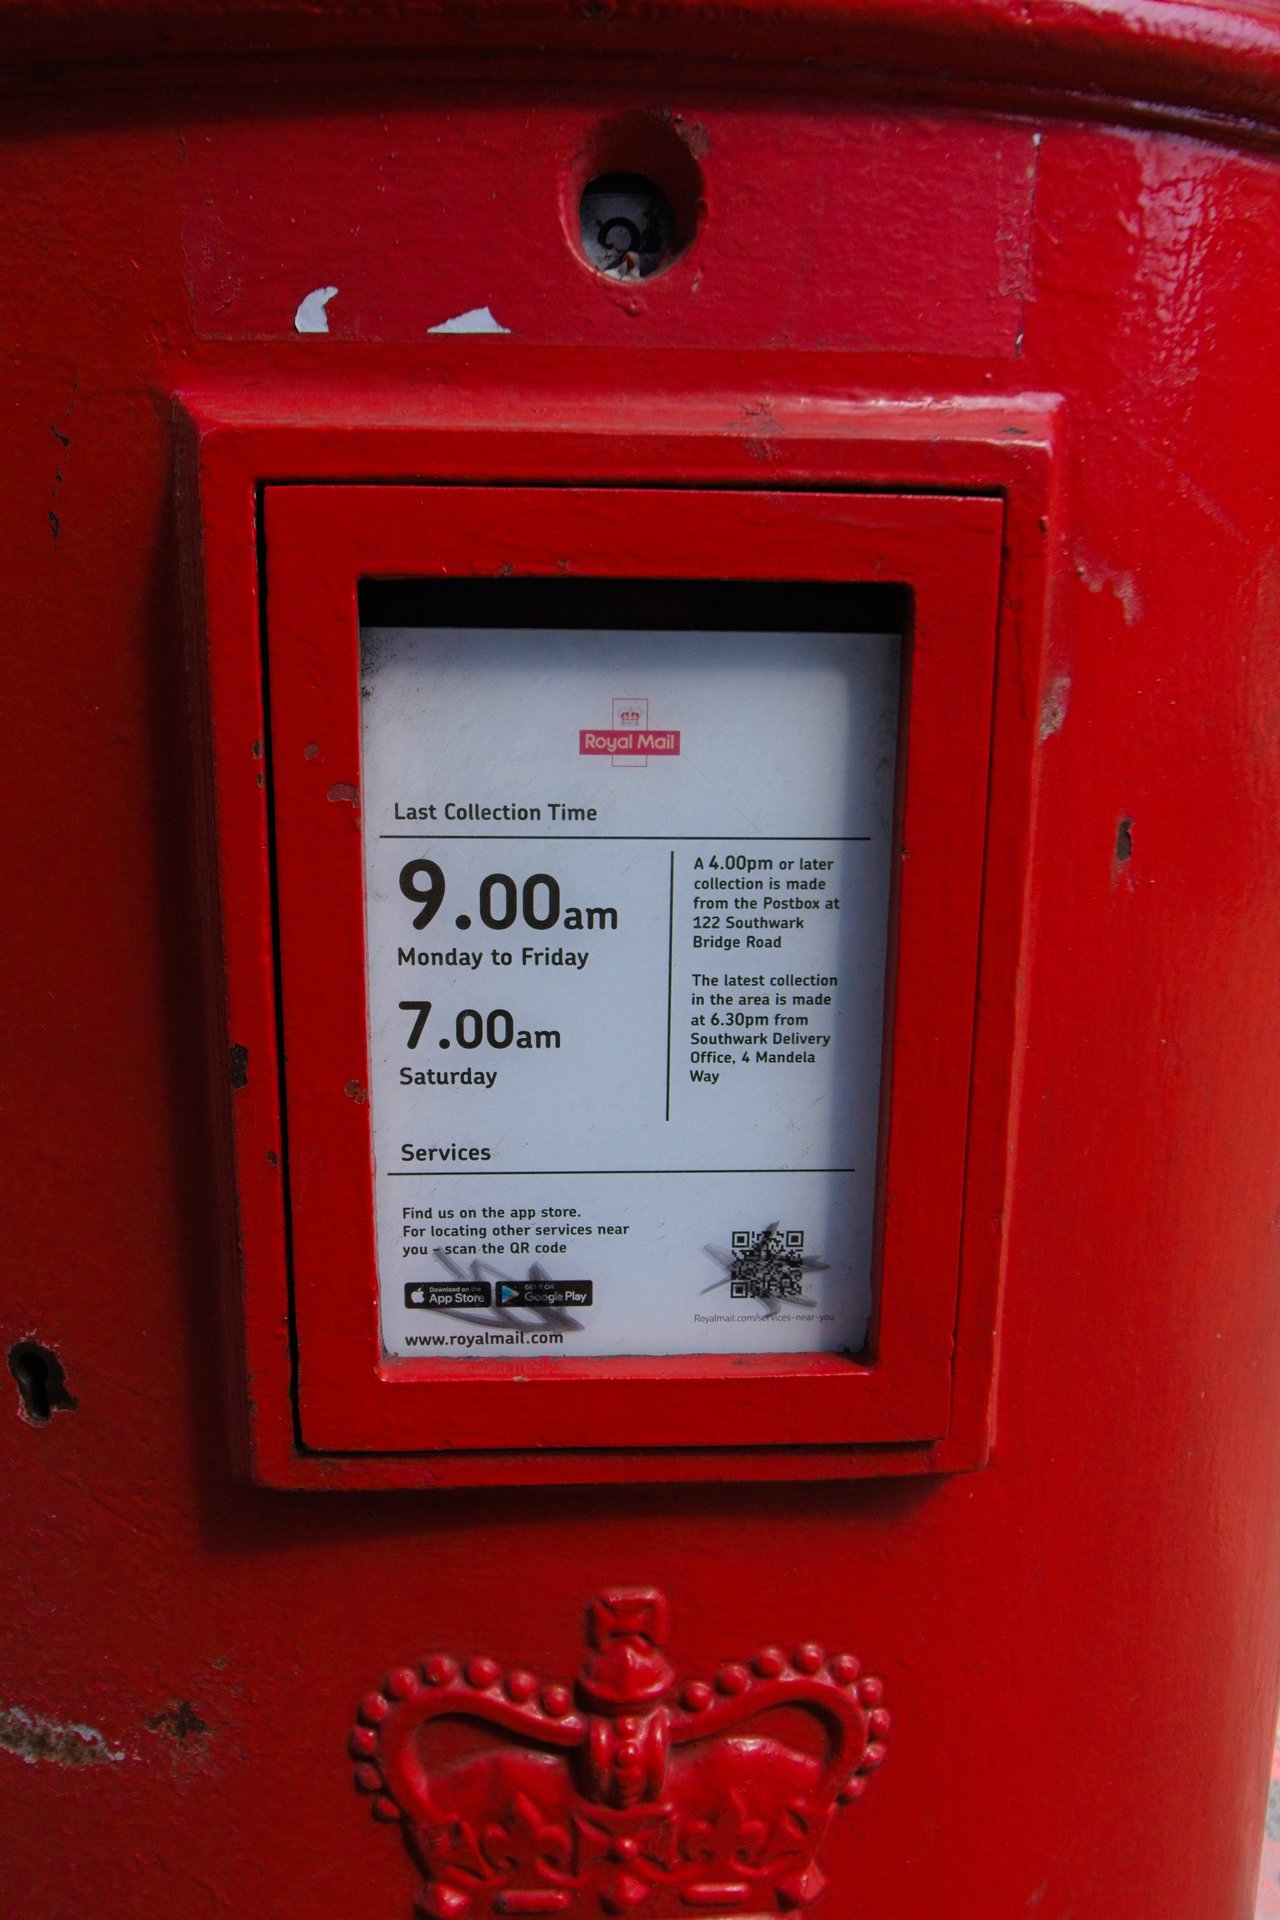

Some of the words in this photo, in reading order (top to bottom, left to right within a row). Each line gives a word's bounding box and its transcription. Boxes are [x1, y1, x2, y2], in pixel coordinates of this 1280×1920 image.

[585, 734, 632, 752] Royal
[637, 735, 674, 749] Mail
[394, 803, 437, 822] Last
[444, 803, 540, 822] Collection
[548, 803, 597, 822] Time
[694, 857, 703, 870] A
[709, 856, 772, 872] 4.00pm
[779, 860, 794, 870] or
[800, 858, 834, 870] later
[694, 878, 763, 889] collection
[770, 879, 780, 889] is
[786, 879, 826, 889] made
[399, 859, 618, 930] 9.00am
[694, 897, 728, 909] from
[734, 898, 757, 909] the
[763, 897, 819, 909] Postbox
[825, 898, 839, 909] at
[693, 917, 720, 929] 122
[726, 917, 804, 929] Southwark
[693, 936, 740, 950] Bridge
[747, 936, 782, 948] Road
[398, 948, 482, 969] Monday
[492, 950, 512, 965] to
[522, 947, 589, 969] Friday
[692, 974, 718, 986] The
[724, 974, 764, 986] latest
[770, 974, 838, 986] collection
[692, 994, 704, 1005] in
[710, 994, 733, 1005] the
[739, 996, 769, 1005] area
[776, 994, 786, 1005] is
[793, 993, 831, 1005] made
[399, 1001, 561, 1049] 7.00am
[691, 1015, 705, 1025] at
[711, 1013, 768, 1028] 6.30pm
[775, 1014, 808, 1025] from
[691, 1033, 767, 1044] Southwark
[773, 1033, 830, 1047] Delivery
[691, 1052, 736, 1064] Office,
[742, 1052, 750, 1063] 4
[756, 1051, 815, 1063] Mandela
[400, 1068, 497, 1088] Saturday
[690, 1070, 719, 1084] Way
[402, 1144, 490, 1161] Services
[403, 1208, 432, 1218] Find
[438, 1209, 454, 1218] us
[460, 1209, 476, 1218] on
[482, 1207, 504, 1218] the
[511, 1209, 535, 1220] app
[542, 1208, 581, 1217] store.
[403, 1226, 426, 1237] For
[431, 1226, 486, 1238] locating
[493, 1225, 530, 1236] other
[536, 1224, 592, 1235] services
[598, 1225, 629, 1235] near
[403, 1244, 427, 1257] you
[445, 1244, 476, 1254] scan
[482, 1243, 504, 1254] the
[510, 1243, 529, 1254] QR
[536, 1243, 566, 1253] code
[429, 1294, 454, 1304] App
[456, 1293, 484, 1302] Store
[525, 1292, 563, 1303] Google
[565, 1291, 587, 1302] Play
[405, 1332, 563, 1347] www.royalmail.com
